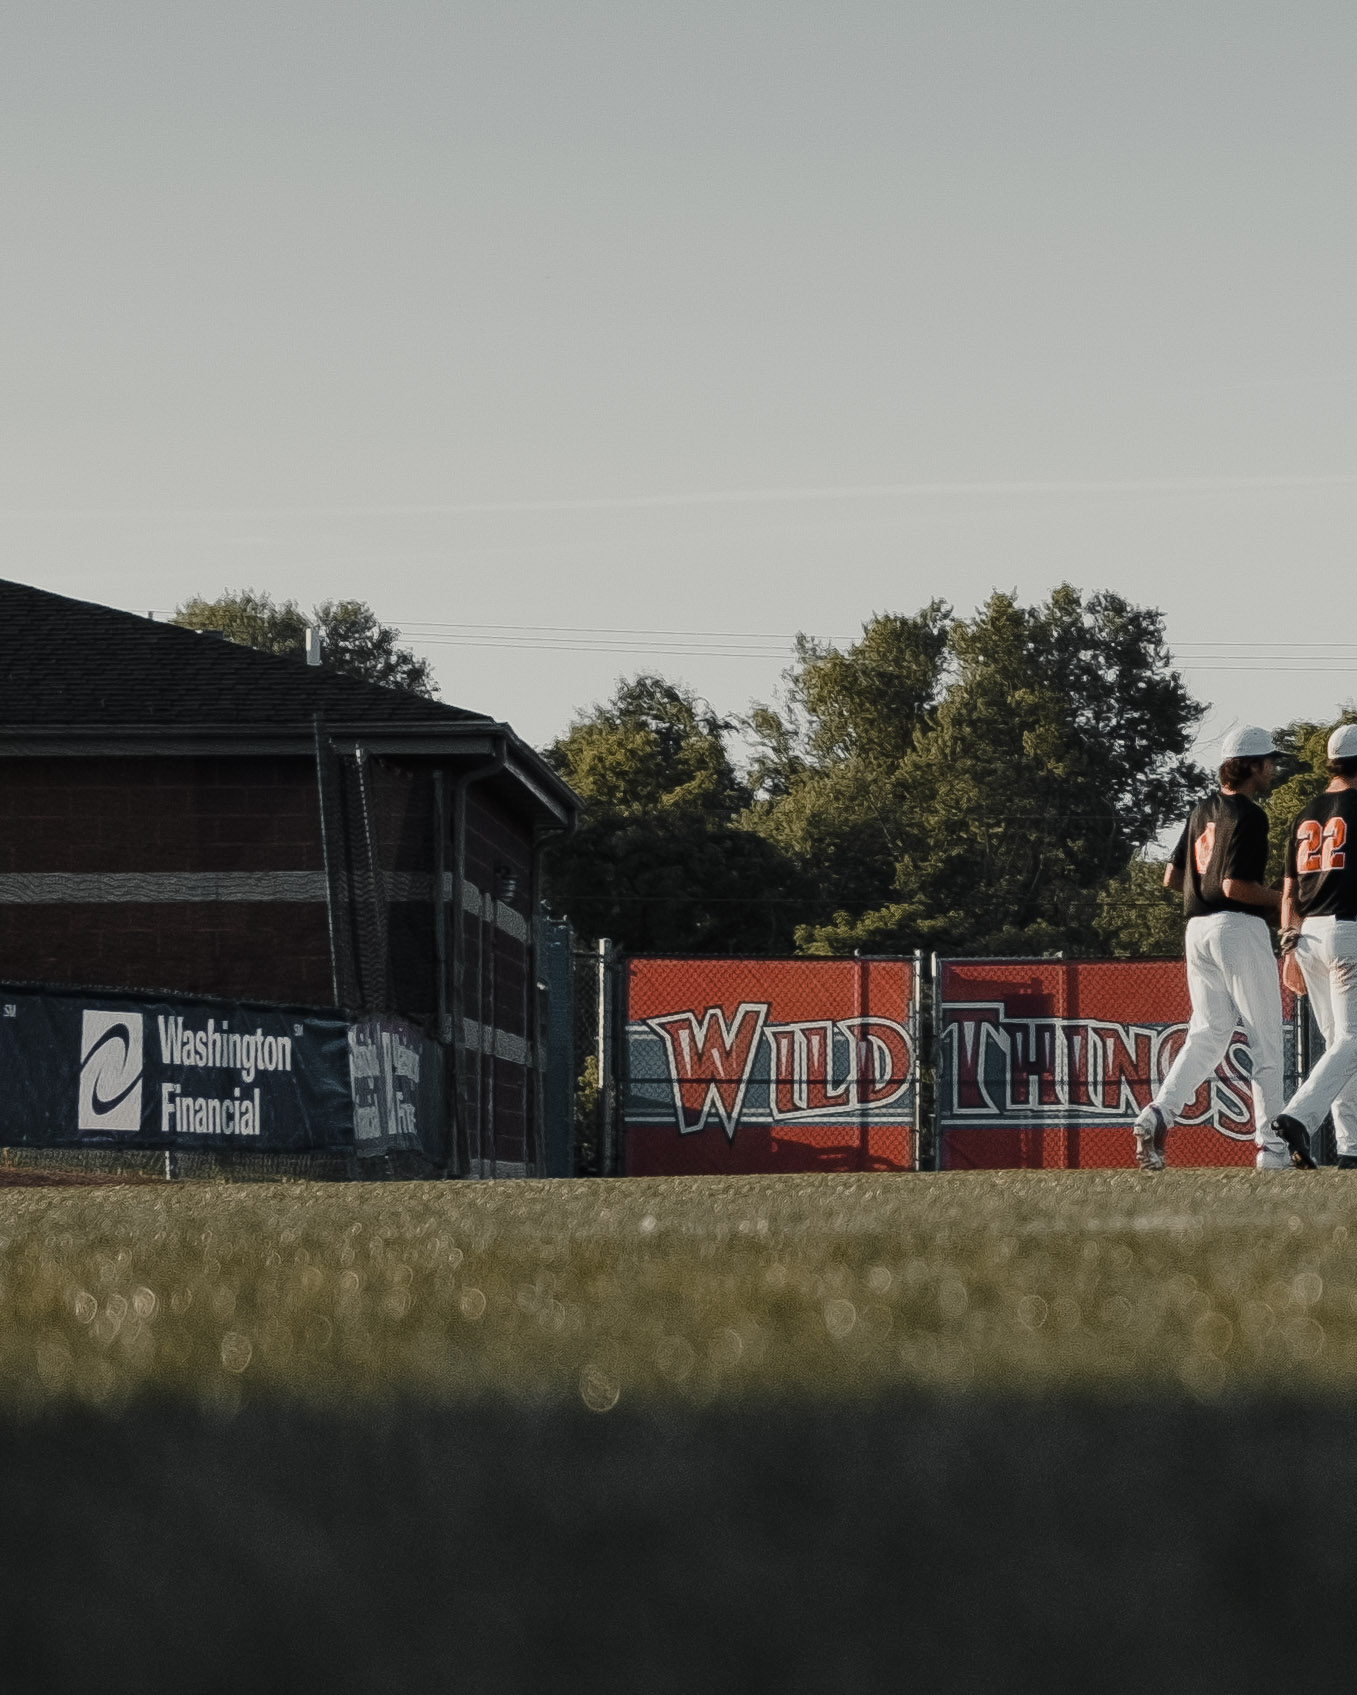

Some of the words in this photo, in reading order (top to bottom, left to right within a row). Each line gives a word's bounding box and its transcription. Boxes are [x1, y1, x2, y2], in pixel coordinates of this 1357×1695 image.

[1296, 816, 1348, 875] 22
[157, 1014, 292, 1083] Washington
[643, 1002, 915, 1145] WILD
[161, 1082, 261, 1136] Financial
